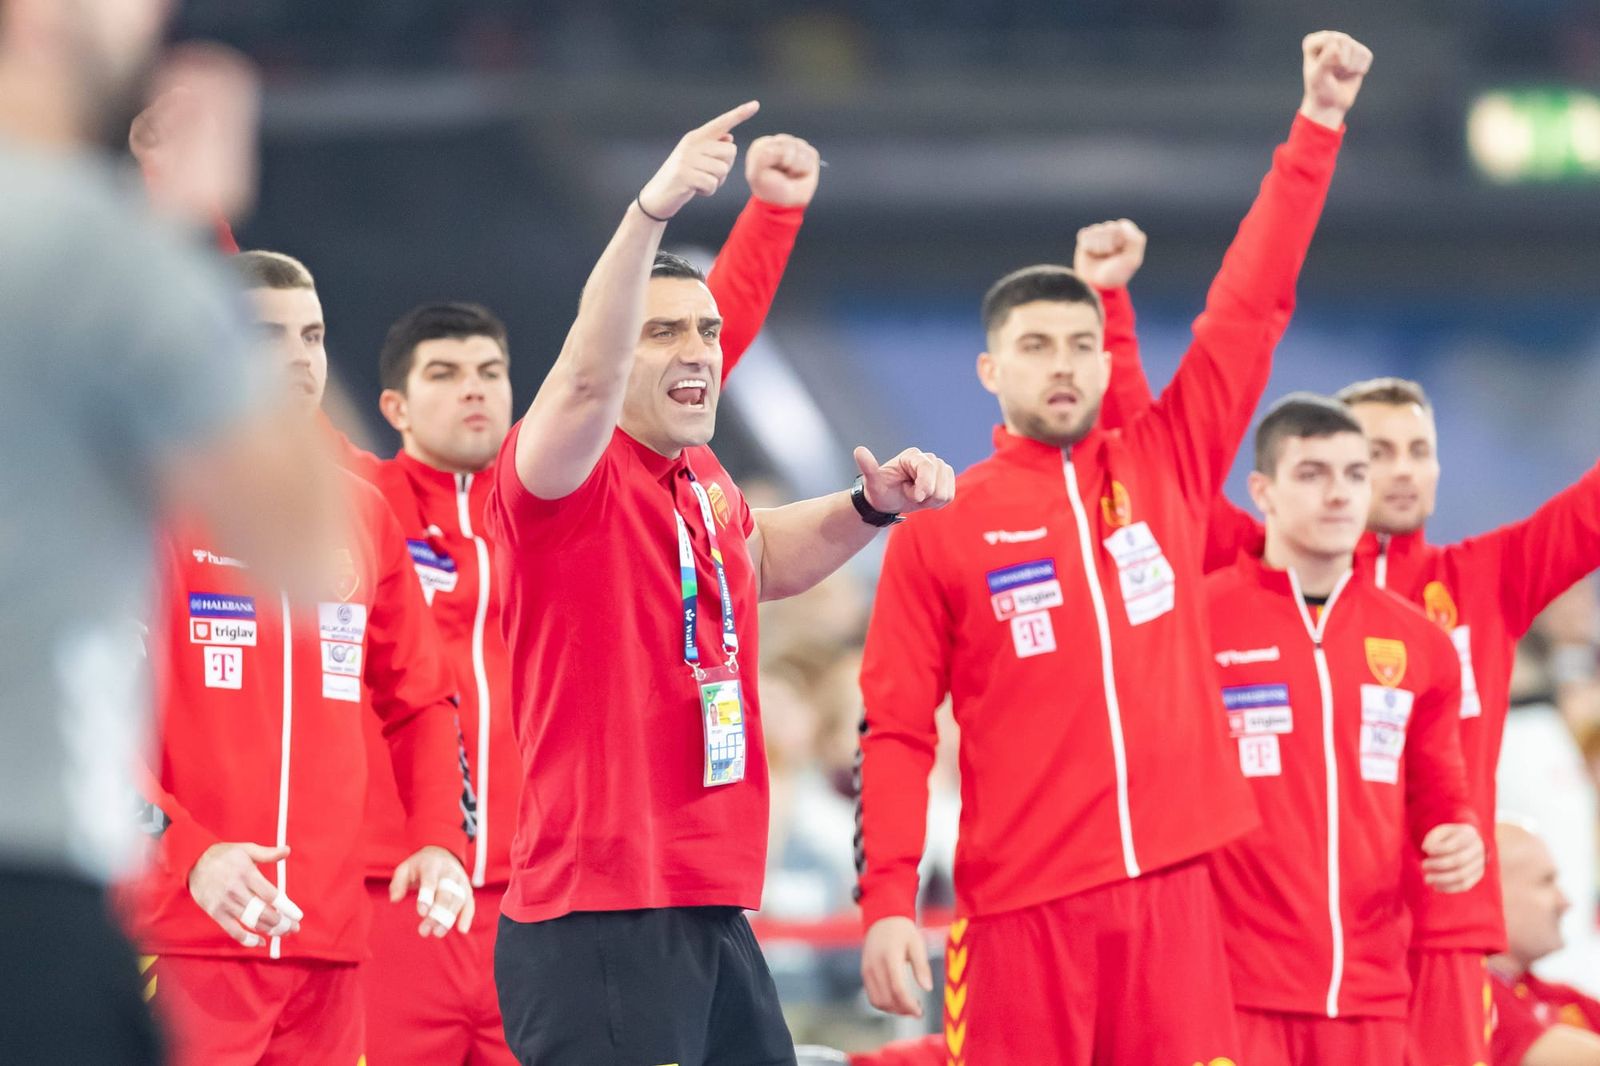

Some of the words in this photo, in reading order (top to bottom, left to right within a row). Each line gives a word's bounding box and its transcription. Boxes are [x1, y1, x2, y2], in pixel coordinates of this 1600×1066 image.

[202, 600, 255, 613] HALKBANK
[215, 625, 254, 640] triglav
[212, 653, 234, 681] T
